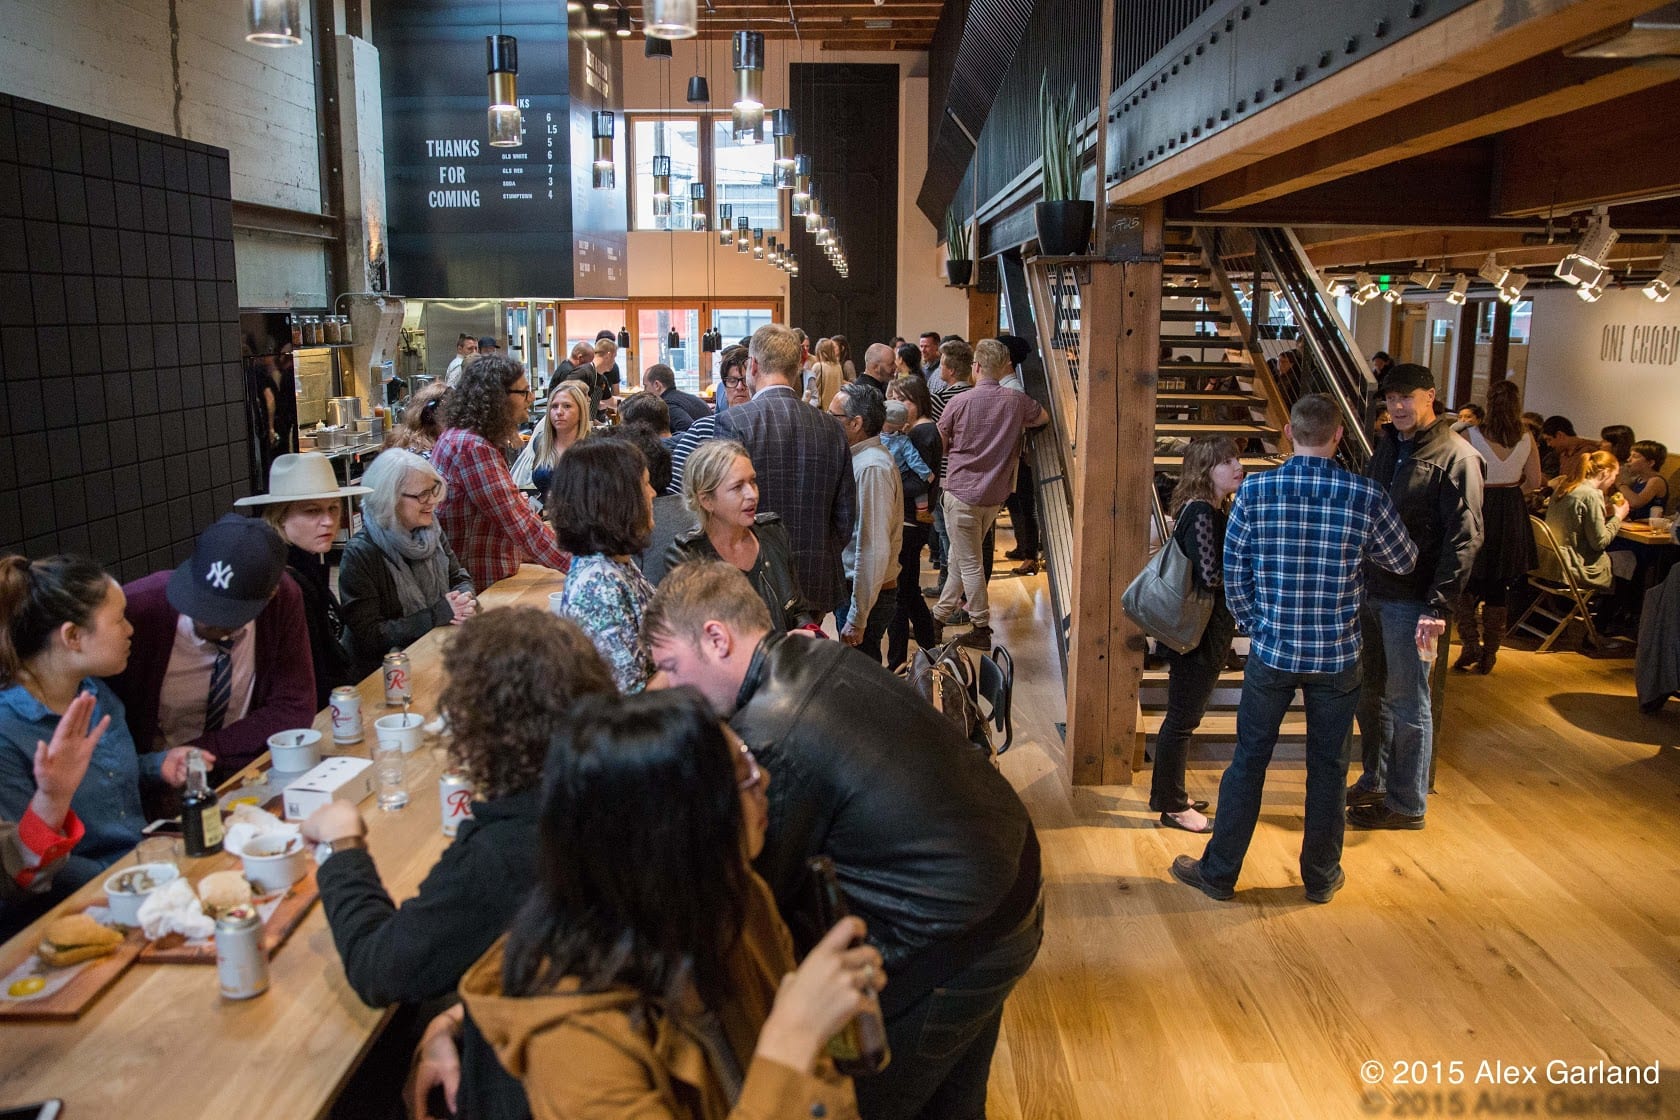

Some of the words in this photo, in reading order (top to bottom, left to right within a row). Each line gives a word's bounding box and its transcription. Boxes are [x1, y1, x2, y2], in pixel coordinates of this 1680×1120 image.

[546, 112, 552, 122] 6
[547, 124, 558, 134] 1.5
[547, 137, 553, 147] 5
[426, 139, 480, 158] THANKS
[547, 150, 553, 160] 6
[547, 164, 553, 174] 7
[439, 166, 466, 184] FOR
[548, 177, 553, 186] 3
[428, 189, 481, 208] COMING
[547, 190, 553, 200] 4
[1600, 324, 1626, 362] ONE
[205, 560, 234, 589] NY
